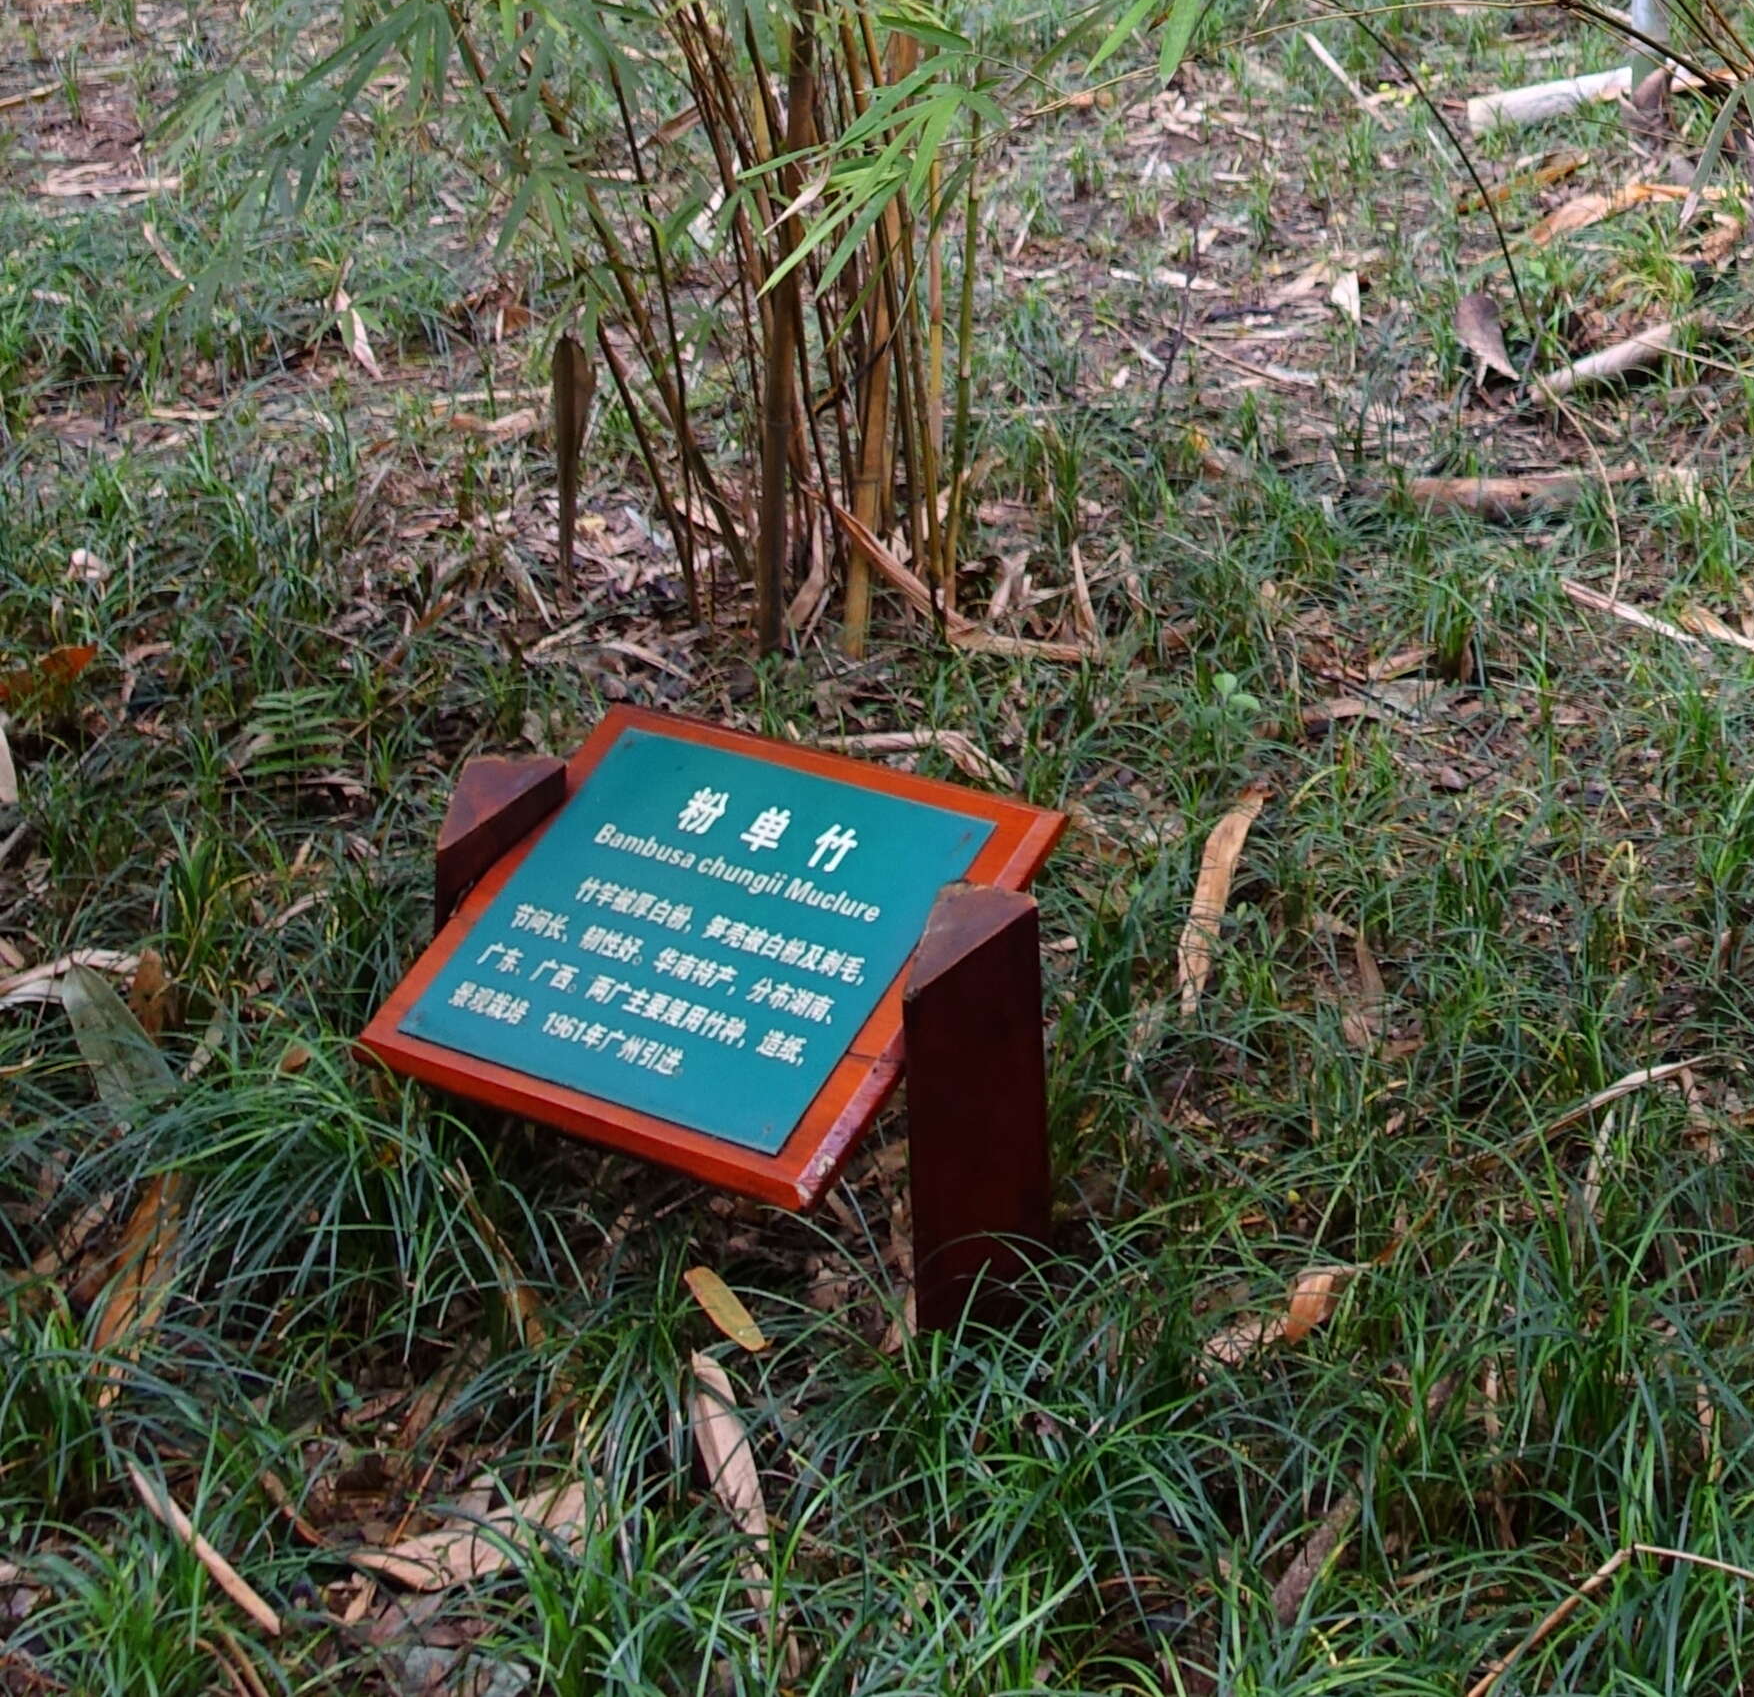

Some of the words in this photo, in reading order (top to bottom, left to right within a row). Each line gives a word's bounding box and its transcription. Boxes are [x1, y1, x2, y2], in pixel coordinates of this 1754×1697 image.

[594, 823, 697, 869] Bambusa
[697, 856, 788, 895] chungii
[783, 877, 881, 922] Muclure
[677, 787, 858, 873] 粉单竹
